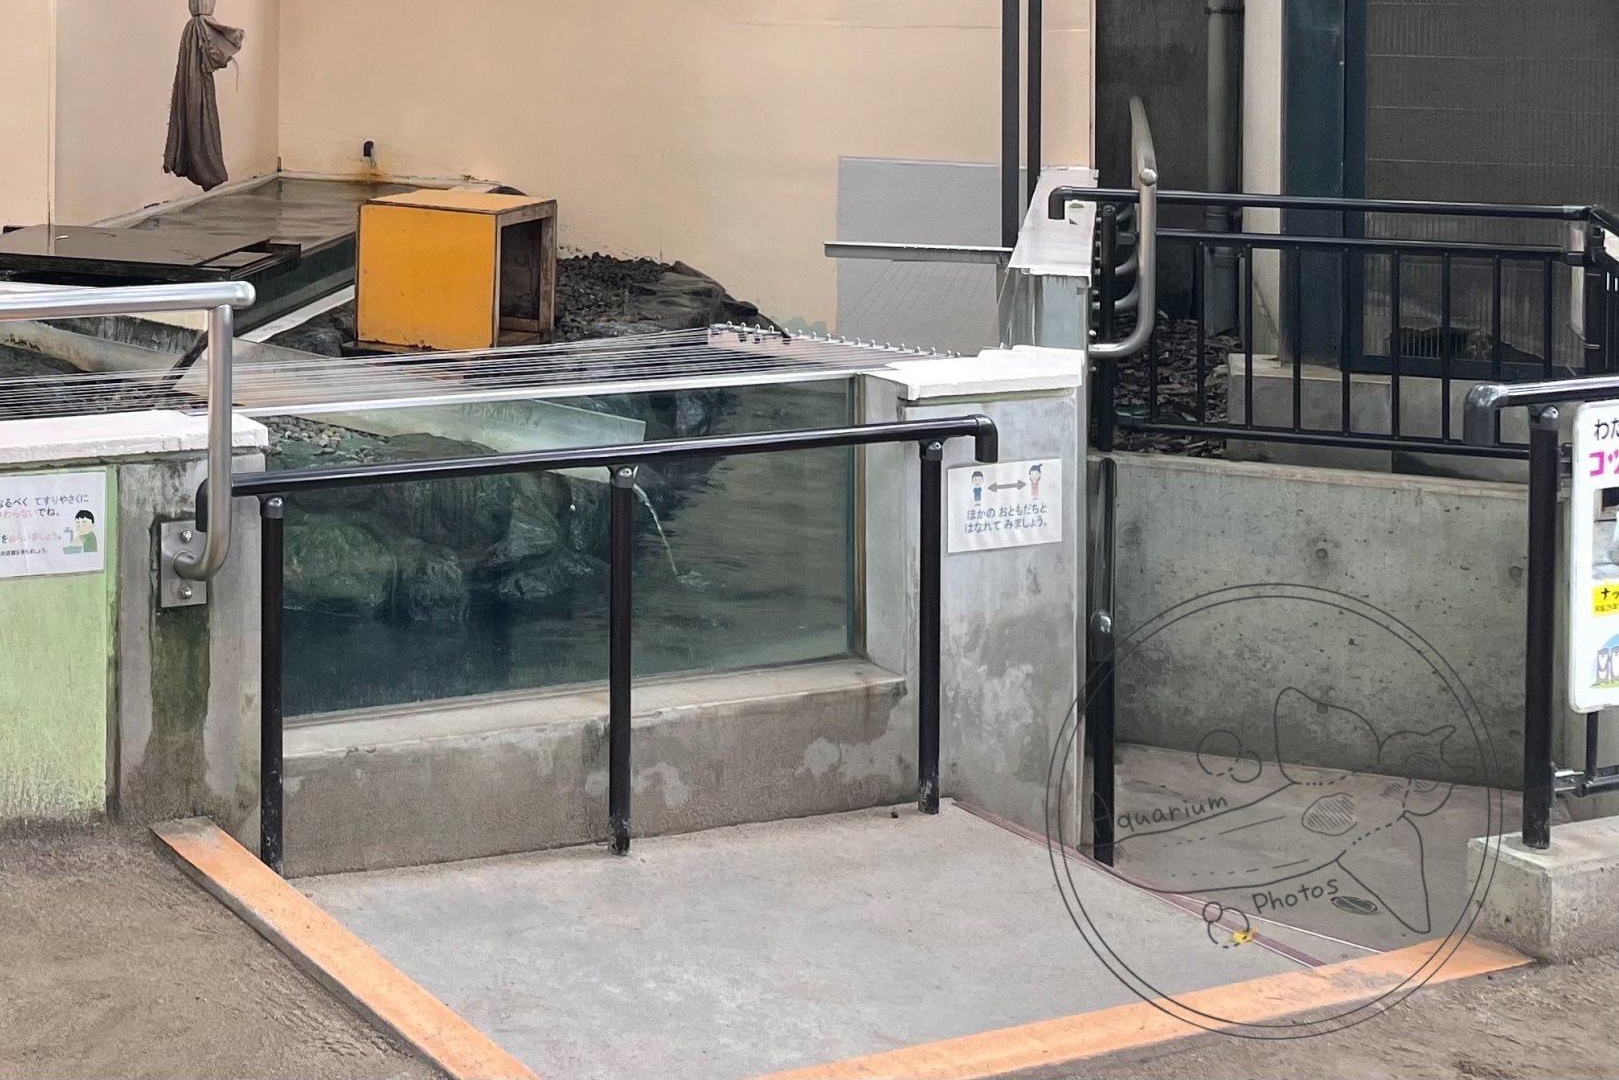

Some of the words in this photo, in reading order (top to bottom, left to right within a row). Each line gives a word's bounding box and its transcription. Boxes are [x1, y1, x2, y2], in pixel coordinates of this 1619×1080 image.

[967, 507, 996, 520] ほかの
[999, 503, 1048, 517] おともだちと
[964, 521, 1001, 534] はなれて
[1004, 516, 1048, 529] みましょう。
